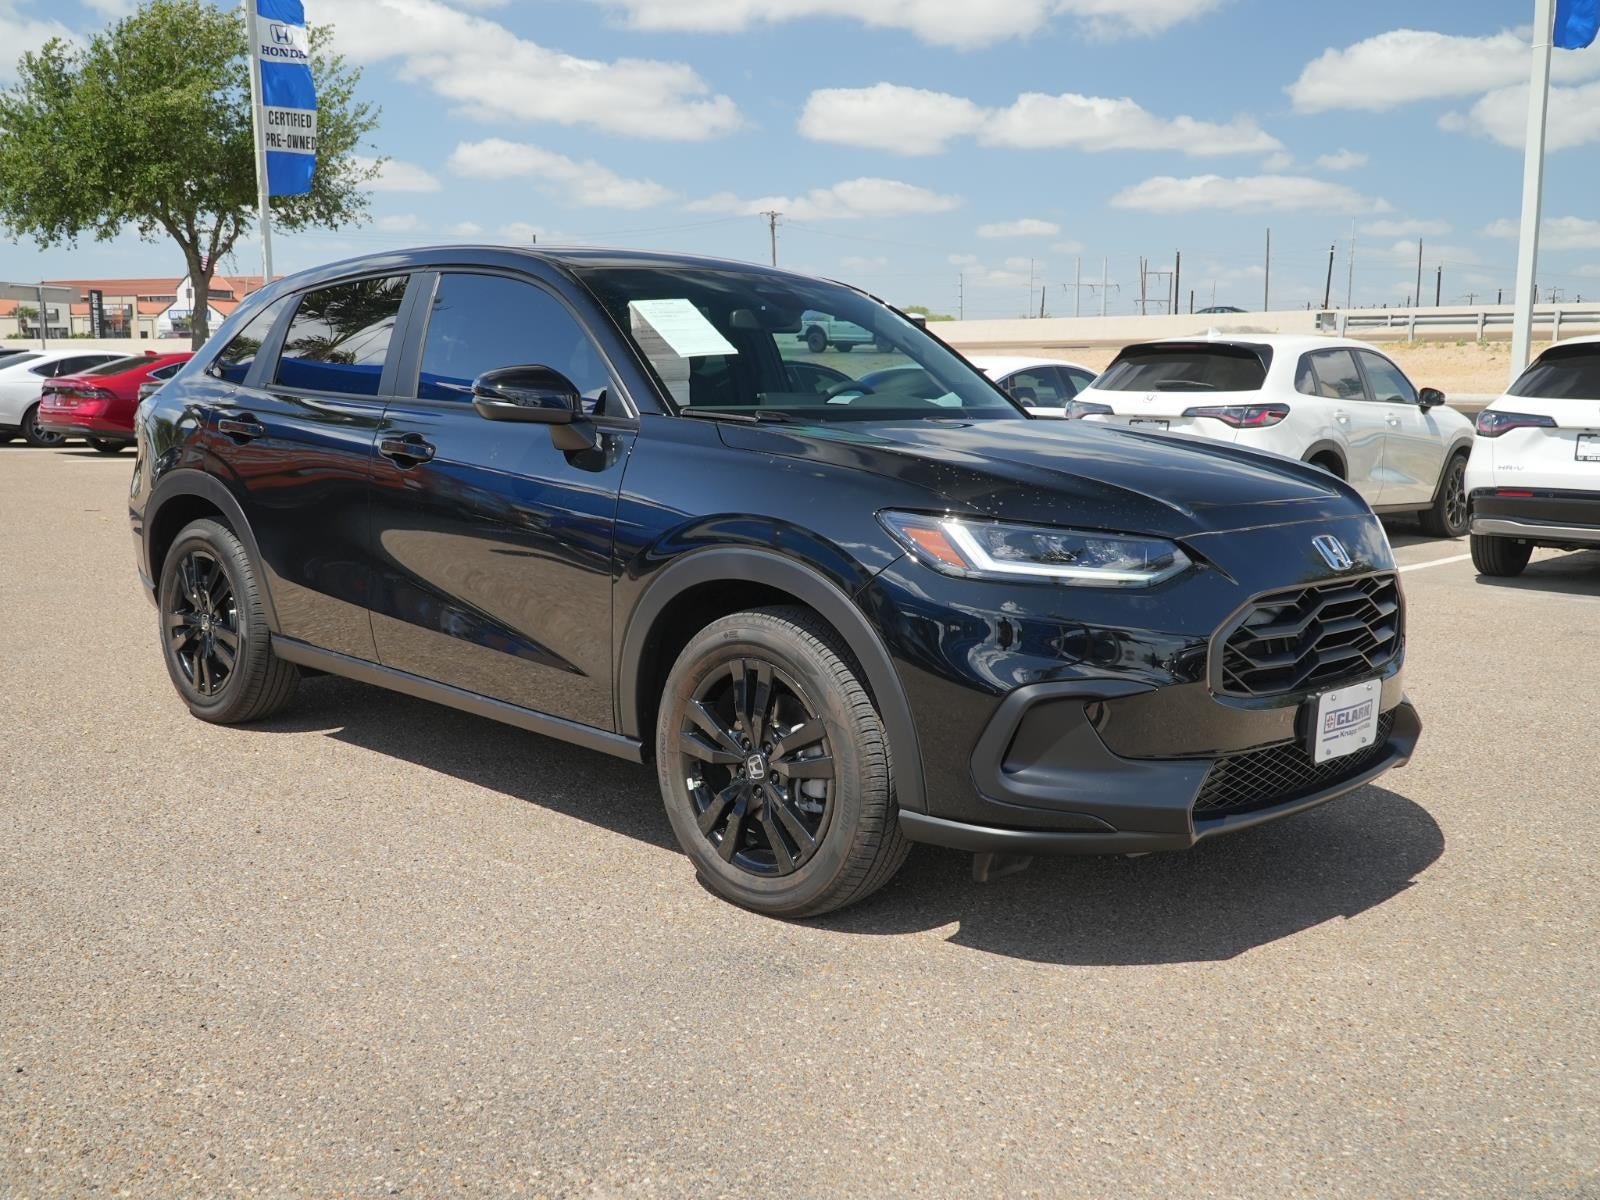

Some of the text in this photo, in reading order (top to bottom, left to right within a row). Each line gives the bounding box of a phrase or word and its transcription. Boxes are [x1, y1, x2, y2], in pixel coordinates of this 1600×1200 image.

[261, 45, 308, 59] HONDA
[268, 110, 312, 129] CERTIFIED
[265, 132, 317, 151] PRE-OWNED
[1336, 703, 1371, 726] CLARK
